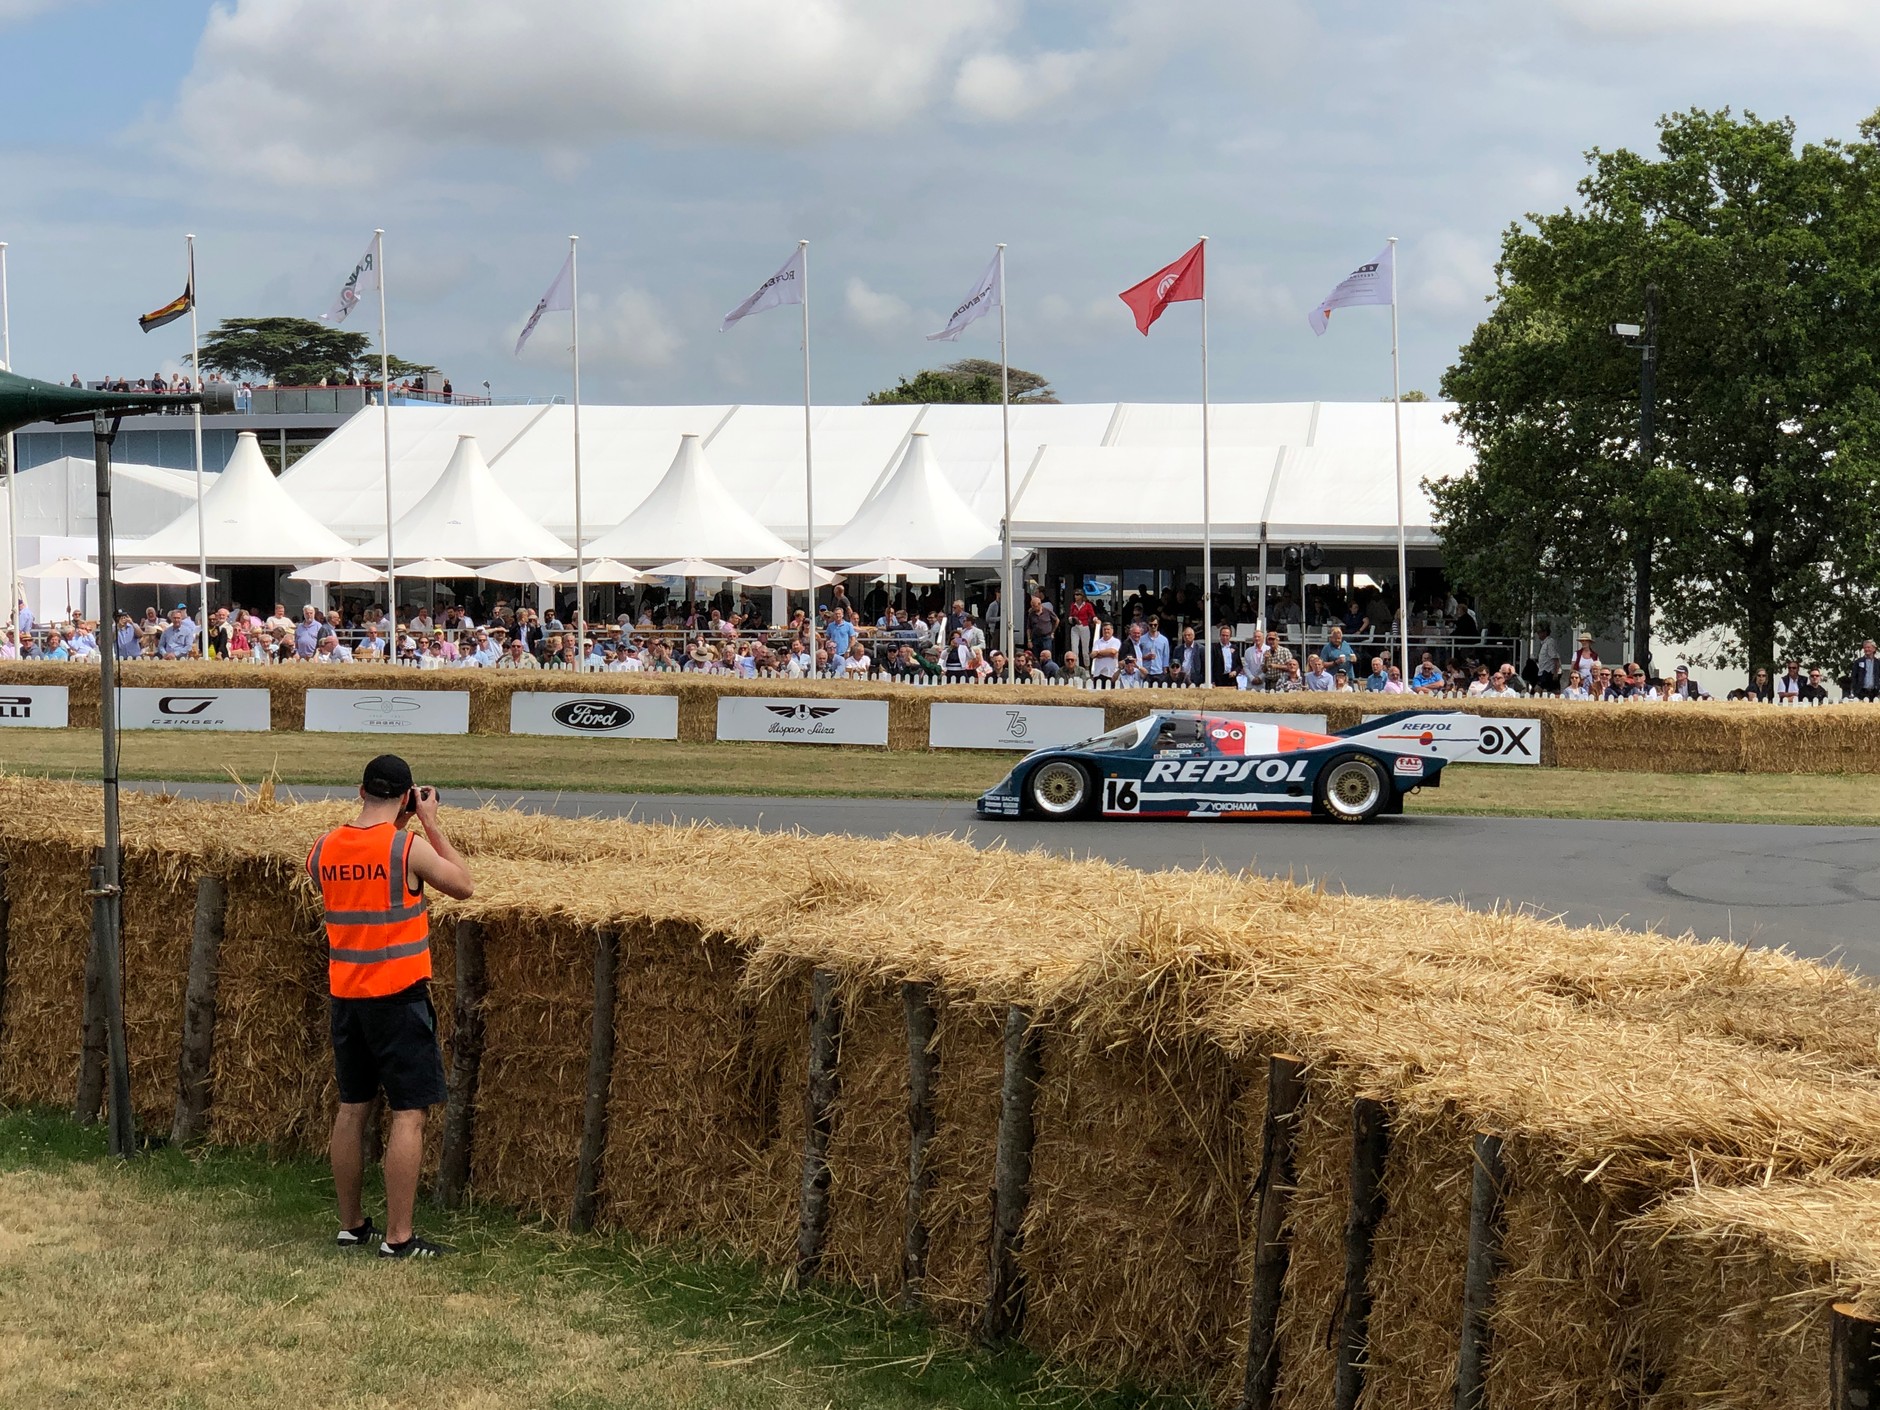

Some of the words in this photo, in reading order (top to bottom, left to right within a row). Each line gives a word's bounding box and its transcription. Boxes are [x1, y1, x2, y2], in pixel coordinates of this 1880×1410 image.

[568, 703, 618, 726] Ford
[1005, 710, 1028, 738] 75
[767, 721, 805, 737] Hispano
[807, 721, 835, 735] Suiza
[1402, 723, 1452, 731] REPSOL
[1144, 760, 1308, 783] REPSOL
[1107, 780, 1138, 811] 16
[1210, 802, 1259, 812] YOKOHAMA
[321, 864, 387, 882] MEDIA
